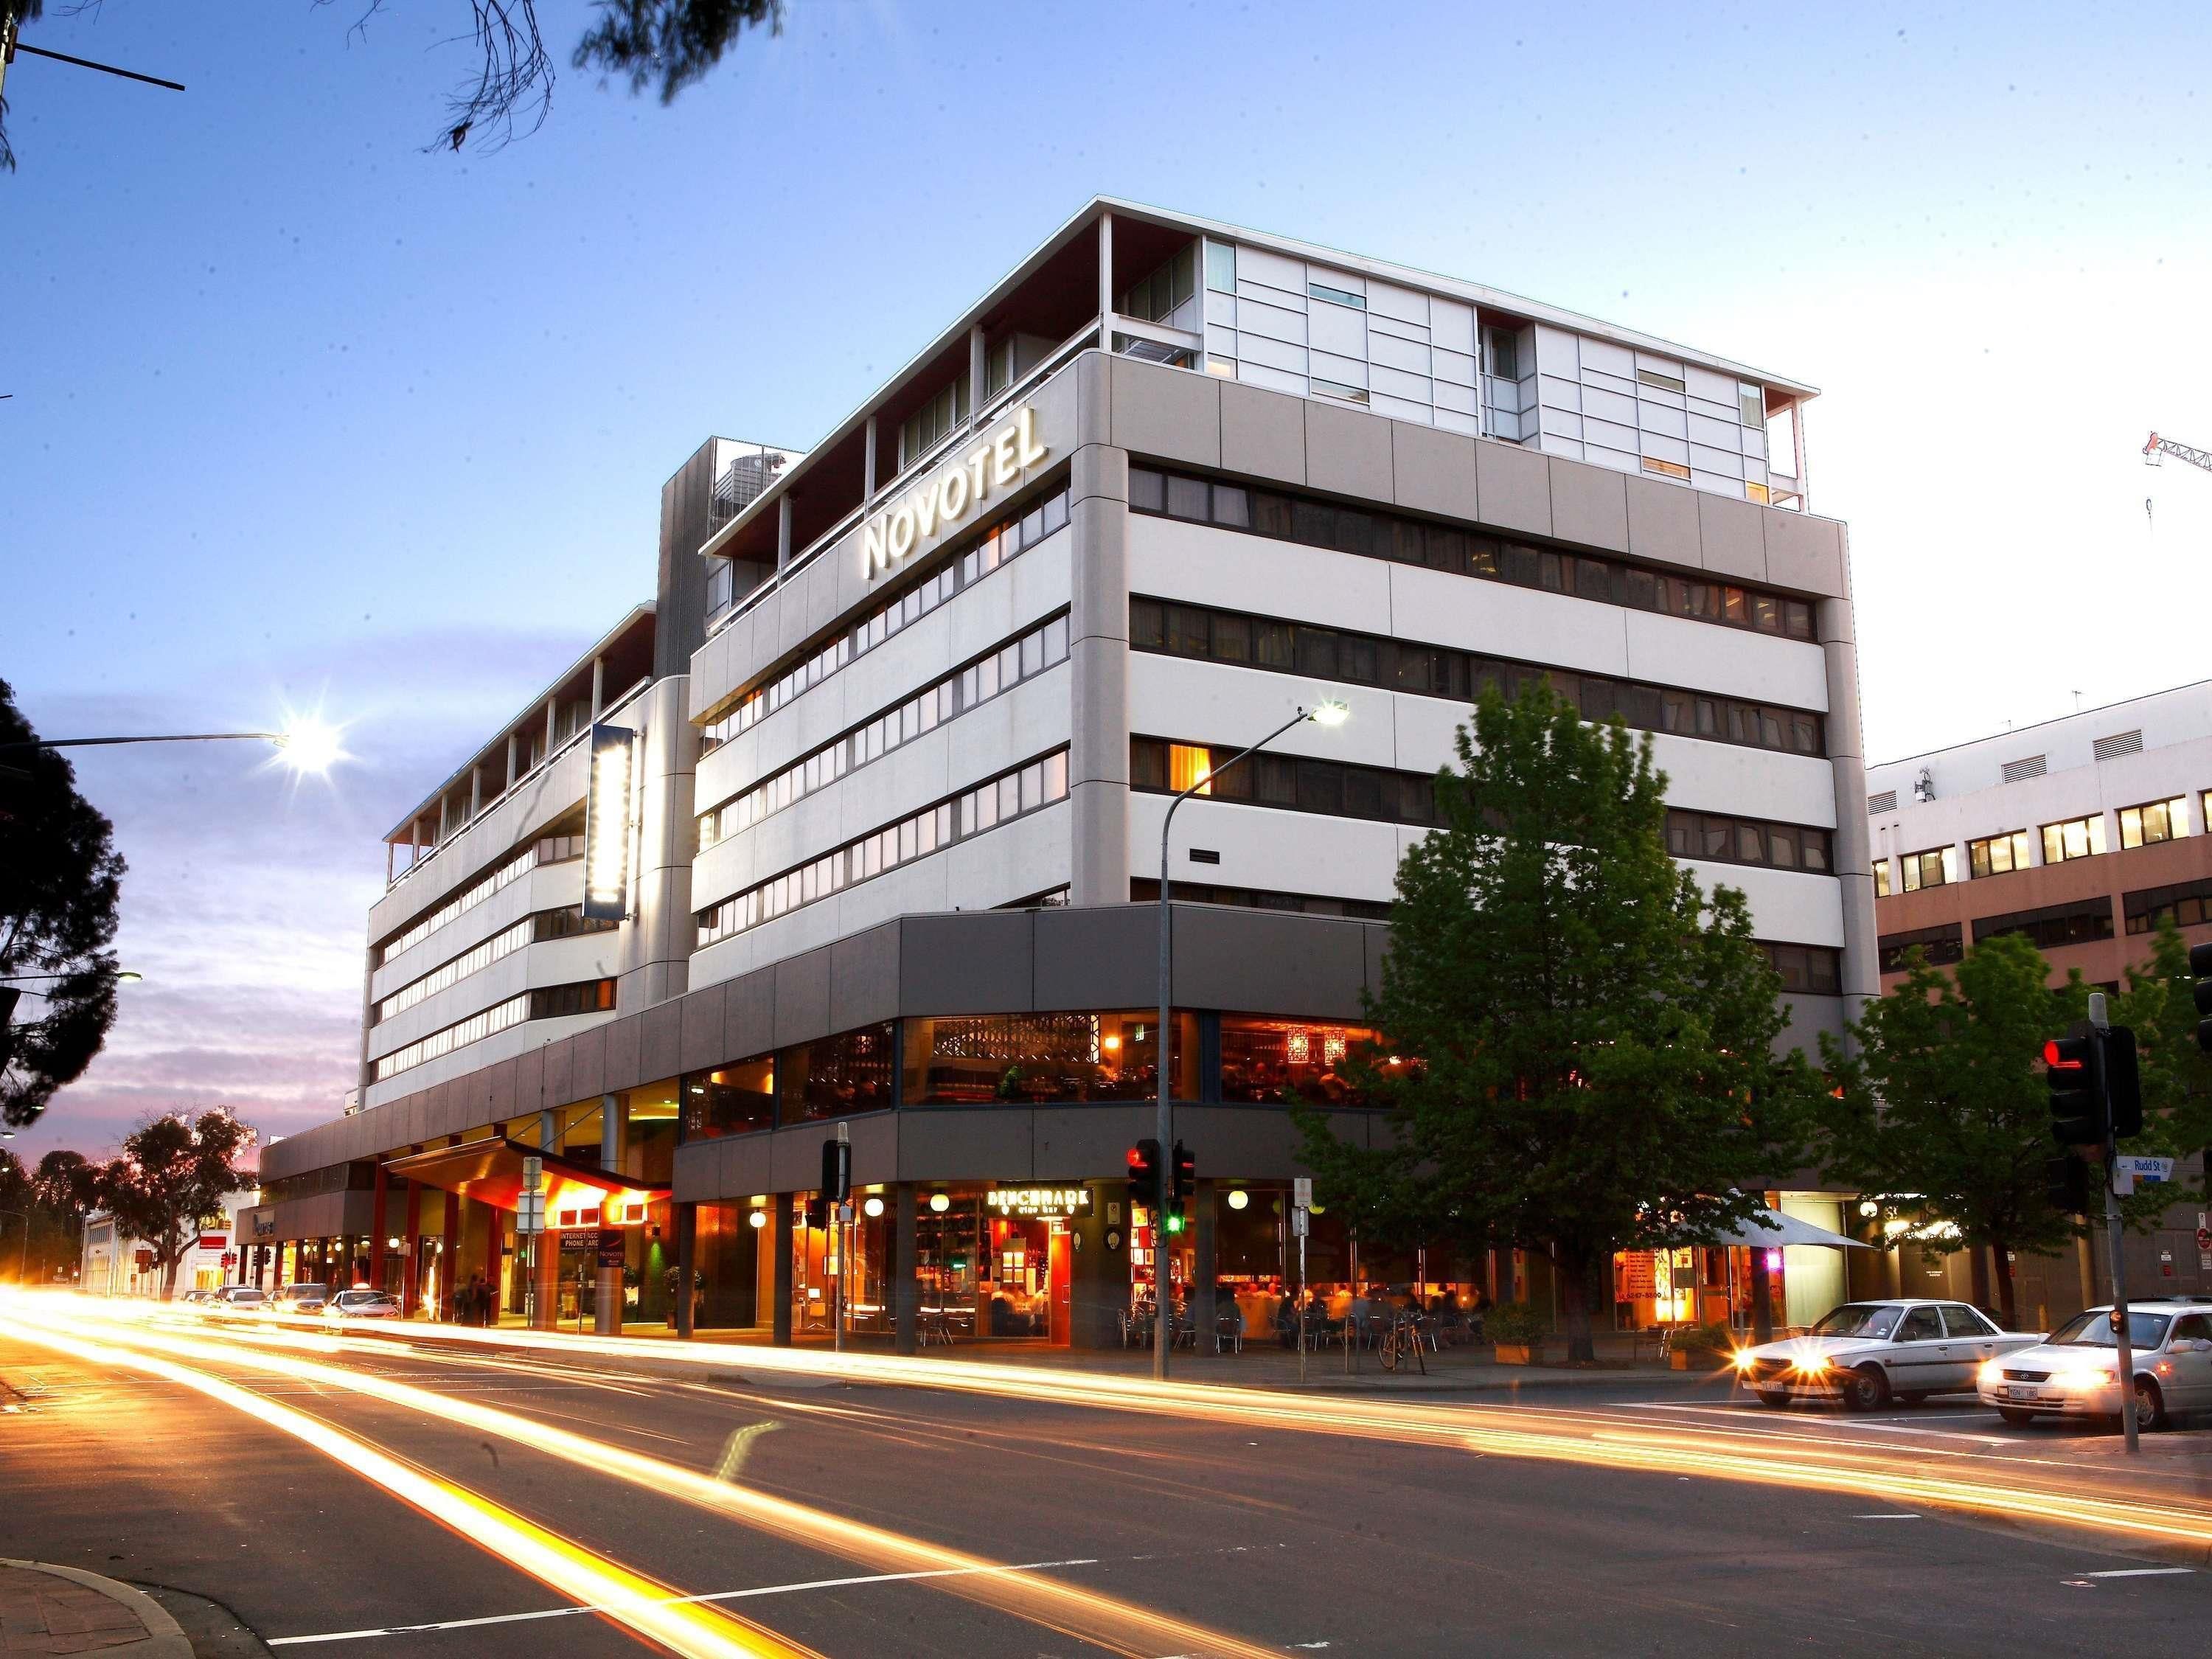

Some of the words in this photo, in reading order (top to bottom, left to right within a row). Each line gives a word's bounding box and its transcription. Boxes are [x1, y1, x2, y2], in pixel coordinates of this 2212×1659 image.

[863, 408, 1049, 580] NOVOTEL
[2135, 1160, 2152, 1171] Rudd
[2154, 1161, 2160, 1172] St
[987, 1190, 1089, 1206] BENCHMARK
